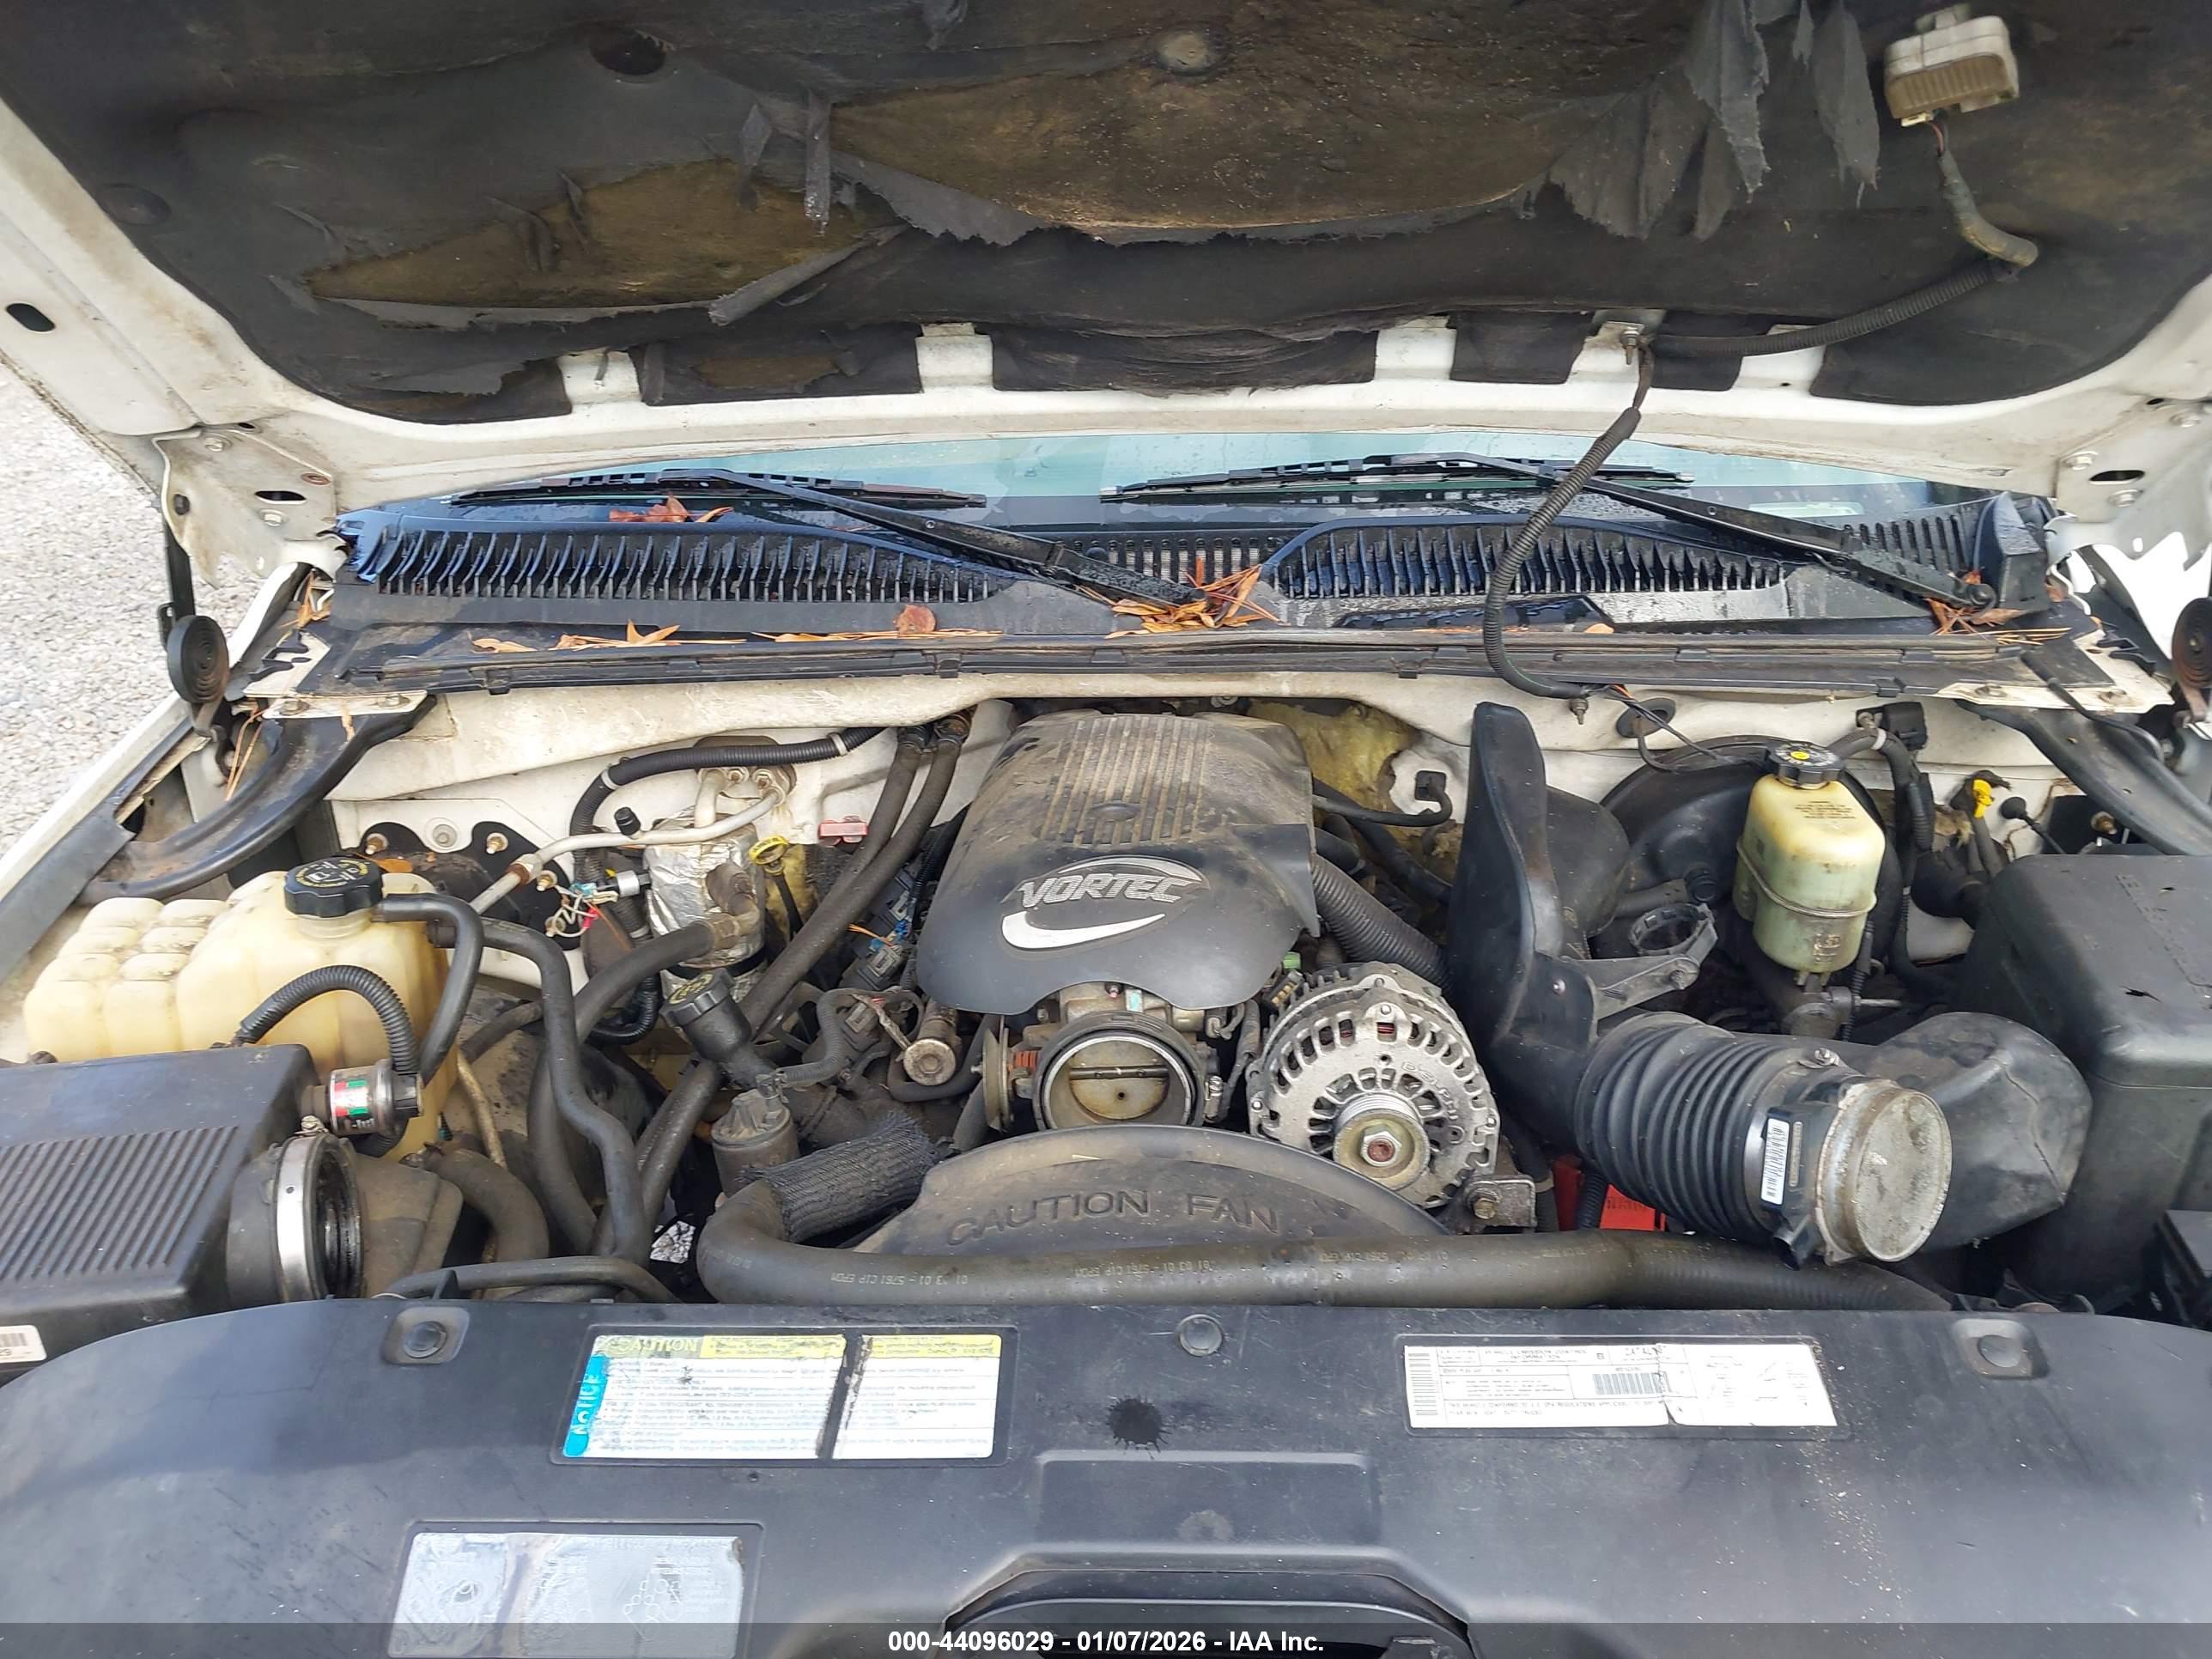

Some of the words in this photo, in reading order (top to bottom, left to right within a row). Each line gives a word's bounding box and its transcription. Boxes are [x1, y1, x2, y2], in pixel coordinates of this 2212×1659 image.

[1017, 872, 1193, 908] VORTEC
[946, 1190, 1149, 1246] CAUTION
[1188, 1193, 1280, 1235] FAN
[617, 1338, 698, 1352] CAUTION
